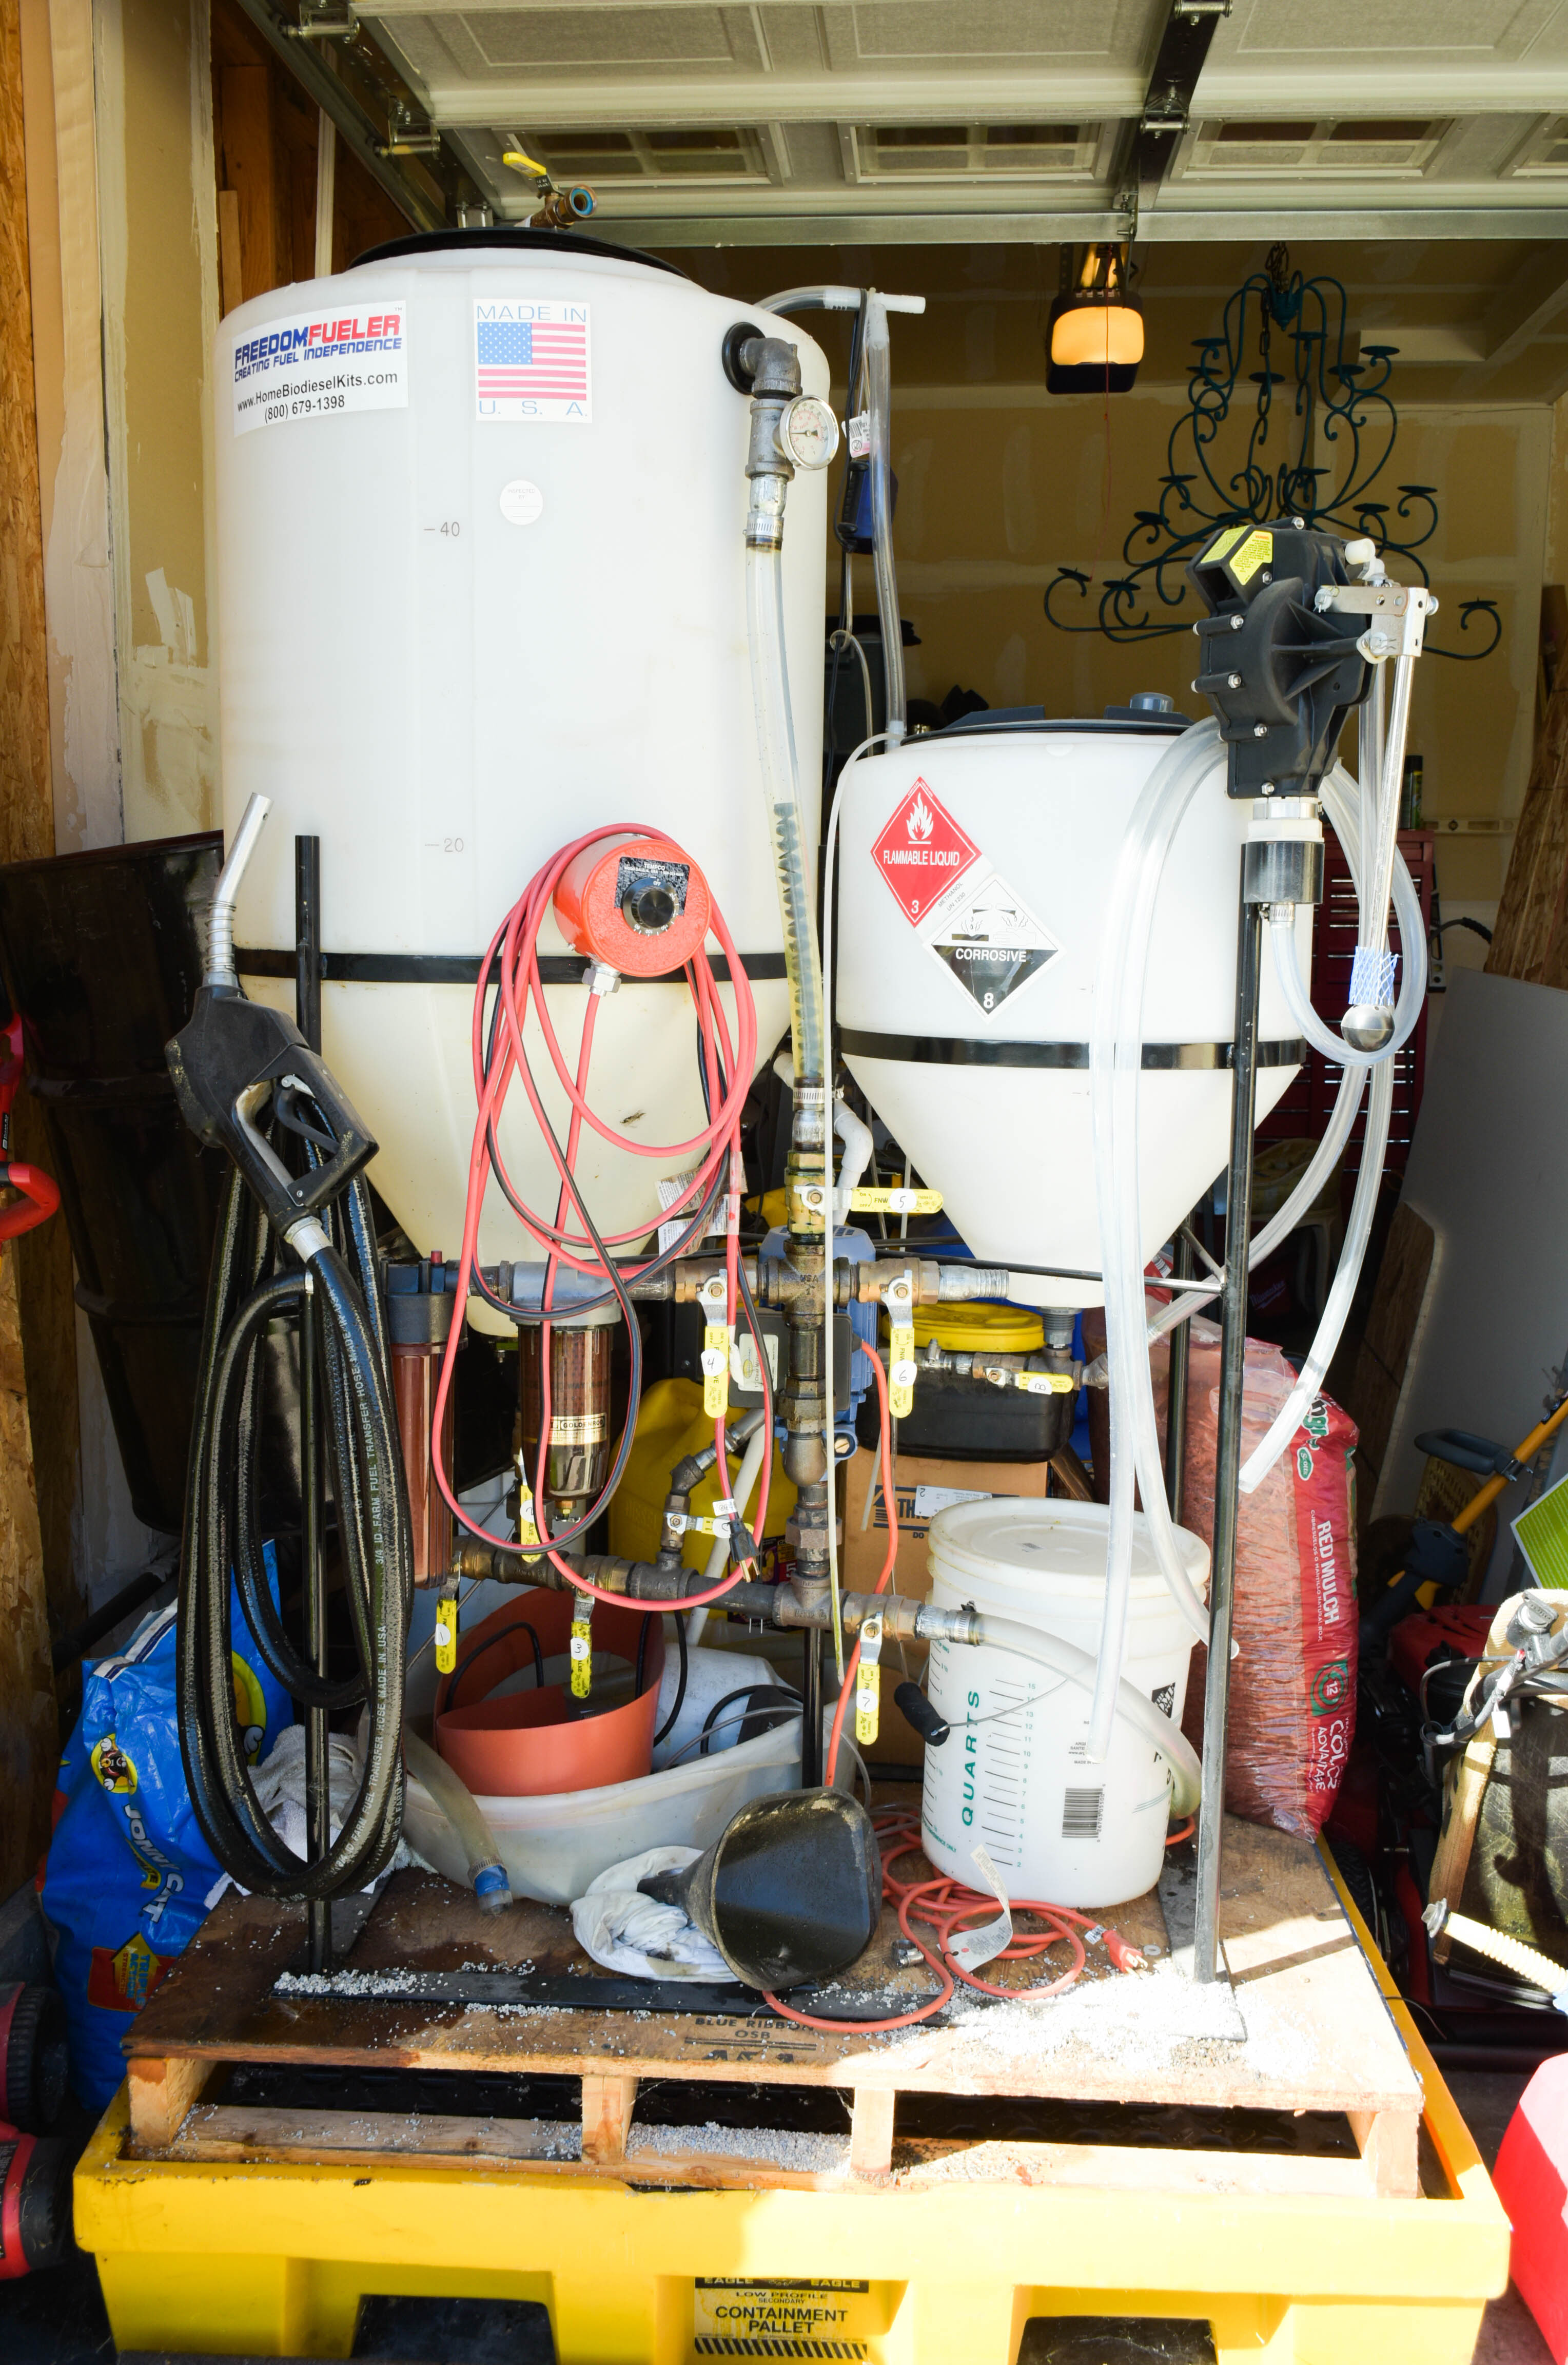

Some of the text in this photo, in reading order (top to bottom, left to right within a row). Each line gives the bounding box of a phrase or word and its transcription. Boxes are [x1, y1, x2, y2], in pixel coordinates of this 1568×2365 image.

[477, 305, 587, 322] MADE IN
[235, 314, 401, 369] FREEDOMFUELER
[234, 338, 402, 382] CREATING FUEL INDEPENDENCE
[237, 371, 398, 412] www.HomeBiodieselKits.com
[264, 395, 345, 423] (800) 679-1398
[478, 400, 587, 417] U. S. A.
[440, 521, 460, 536] 40
[444, 838, 464, 852] 20
[883, 850, 960, 867] FLAMMABLE LIQUID
[938, 882, 963, 907] METHANOL
[911, 900, 919, 914] 3
[947, 902, 954, 911] UN
[955, 948, 1027, 963] CORROSIVE
[983, 992, 994, 1009] 8
[900, 1196, 906, 1208] 5
[342, 1331, 358, 1362] MADE
[708, 1358, 715, 1369] 4
[351, 1367, 365, 1397] HOSE
[899, 1369, 907, 1381] 6
[359, 1403, 375, 1459] TRANSFER
[563, 1420, 603, 1428] GOLDENROD
[368, 1464, 379, 1491] FUEL
[920, 1488, 926, 1497] 2
[371, 1498, 381, 1526] FARM
[374, 1534, 383, 1543] ID
[375, 1549, 384, 1564] 3/4
[1317, 1521, 1339, 1624] RED MULCH
[575, 1643, 582, 1653] 3
[1327, 1681, 1338, 1696] 12
[335, 1625, 387, 1868] 3/4 ID FARM FUEL TRANSFER HOSE MADE IN USA
[962, 1690, 979, 1827] QUARTS
[125, 1804, 180, 1870] JONNY
[143, 1873, 184, 1923] CAT
[695, 2018, 814, 2032] BLUE RIBBON
[735, 2030, 770, 2039] OSB
[811, 2280, 860, 2288] EAGLE
[716, 2306, 848, 2322] CONTAINMENT
[749, 2320, 815, 2333] PALLET
